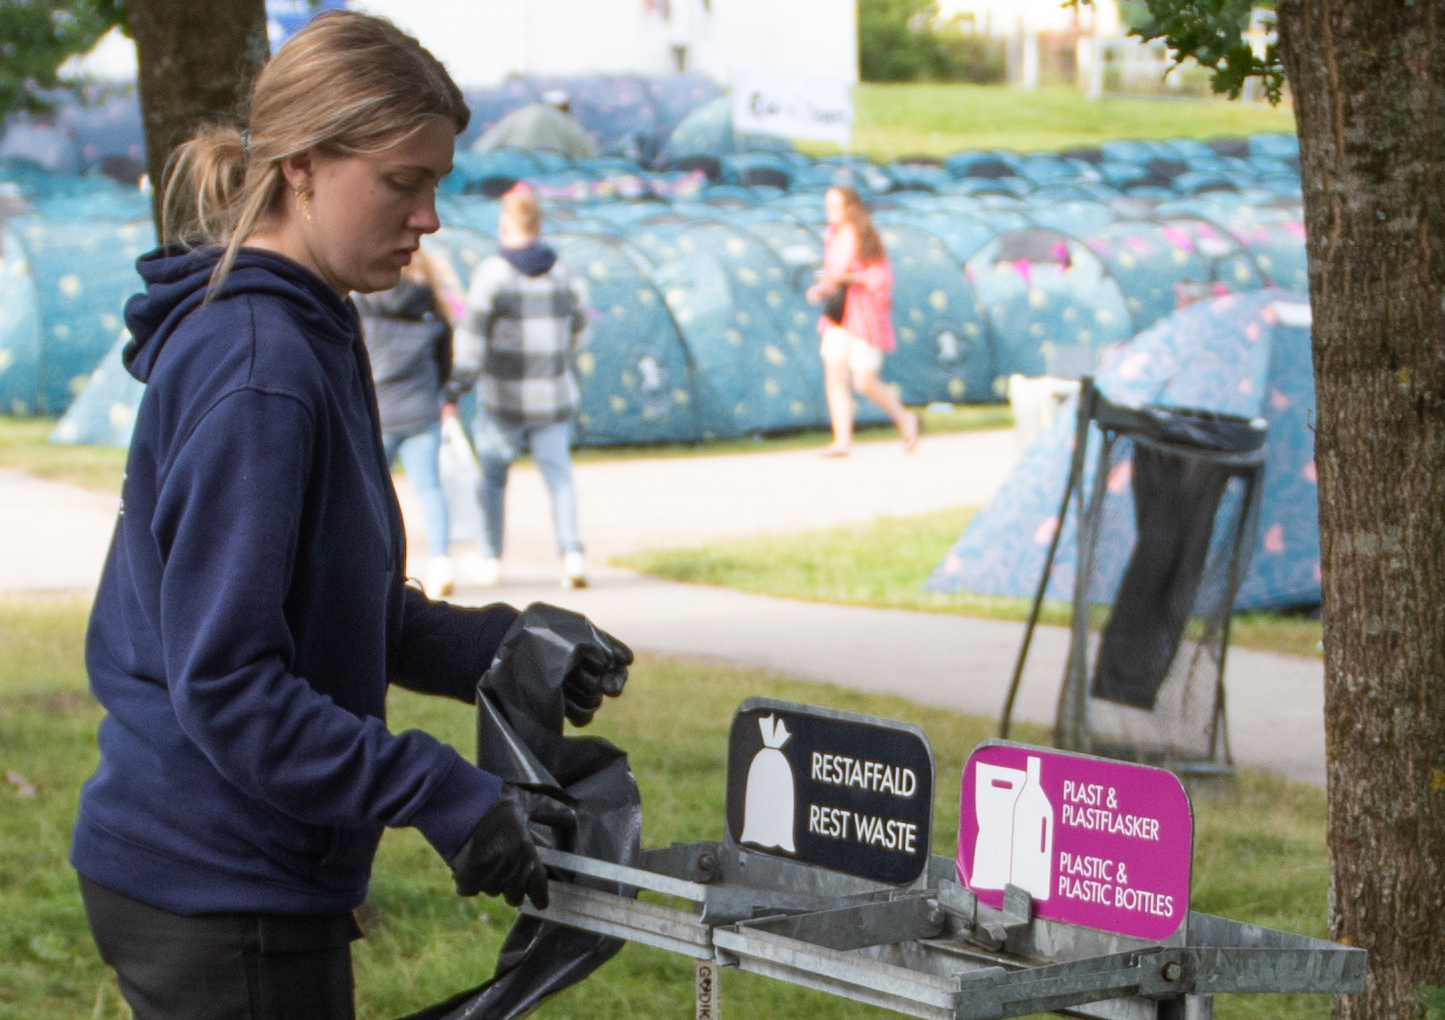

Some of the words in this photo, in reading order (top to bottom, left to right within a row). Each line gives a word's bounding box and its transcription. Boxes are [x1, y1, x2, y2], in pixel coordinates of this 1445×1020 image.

[812, 751, 917, 798] RESTAFFALD
[1063, 779, 1104, 806] PLAST
[1106, 787, 1118, 810] &
[809, 804, 851, 839] REST
[854, 812, 917, 854] WASTE
[1061, 803, 1160, 841] PLASTFLASKER
[1060, 851, 1113, 882] PLASTIC
[1115, 861, 1128, 885] &
[1058, 875, 1112, 906] PLASTIC
[1114, 885, 1174, 918] BOTTLES
